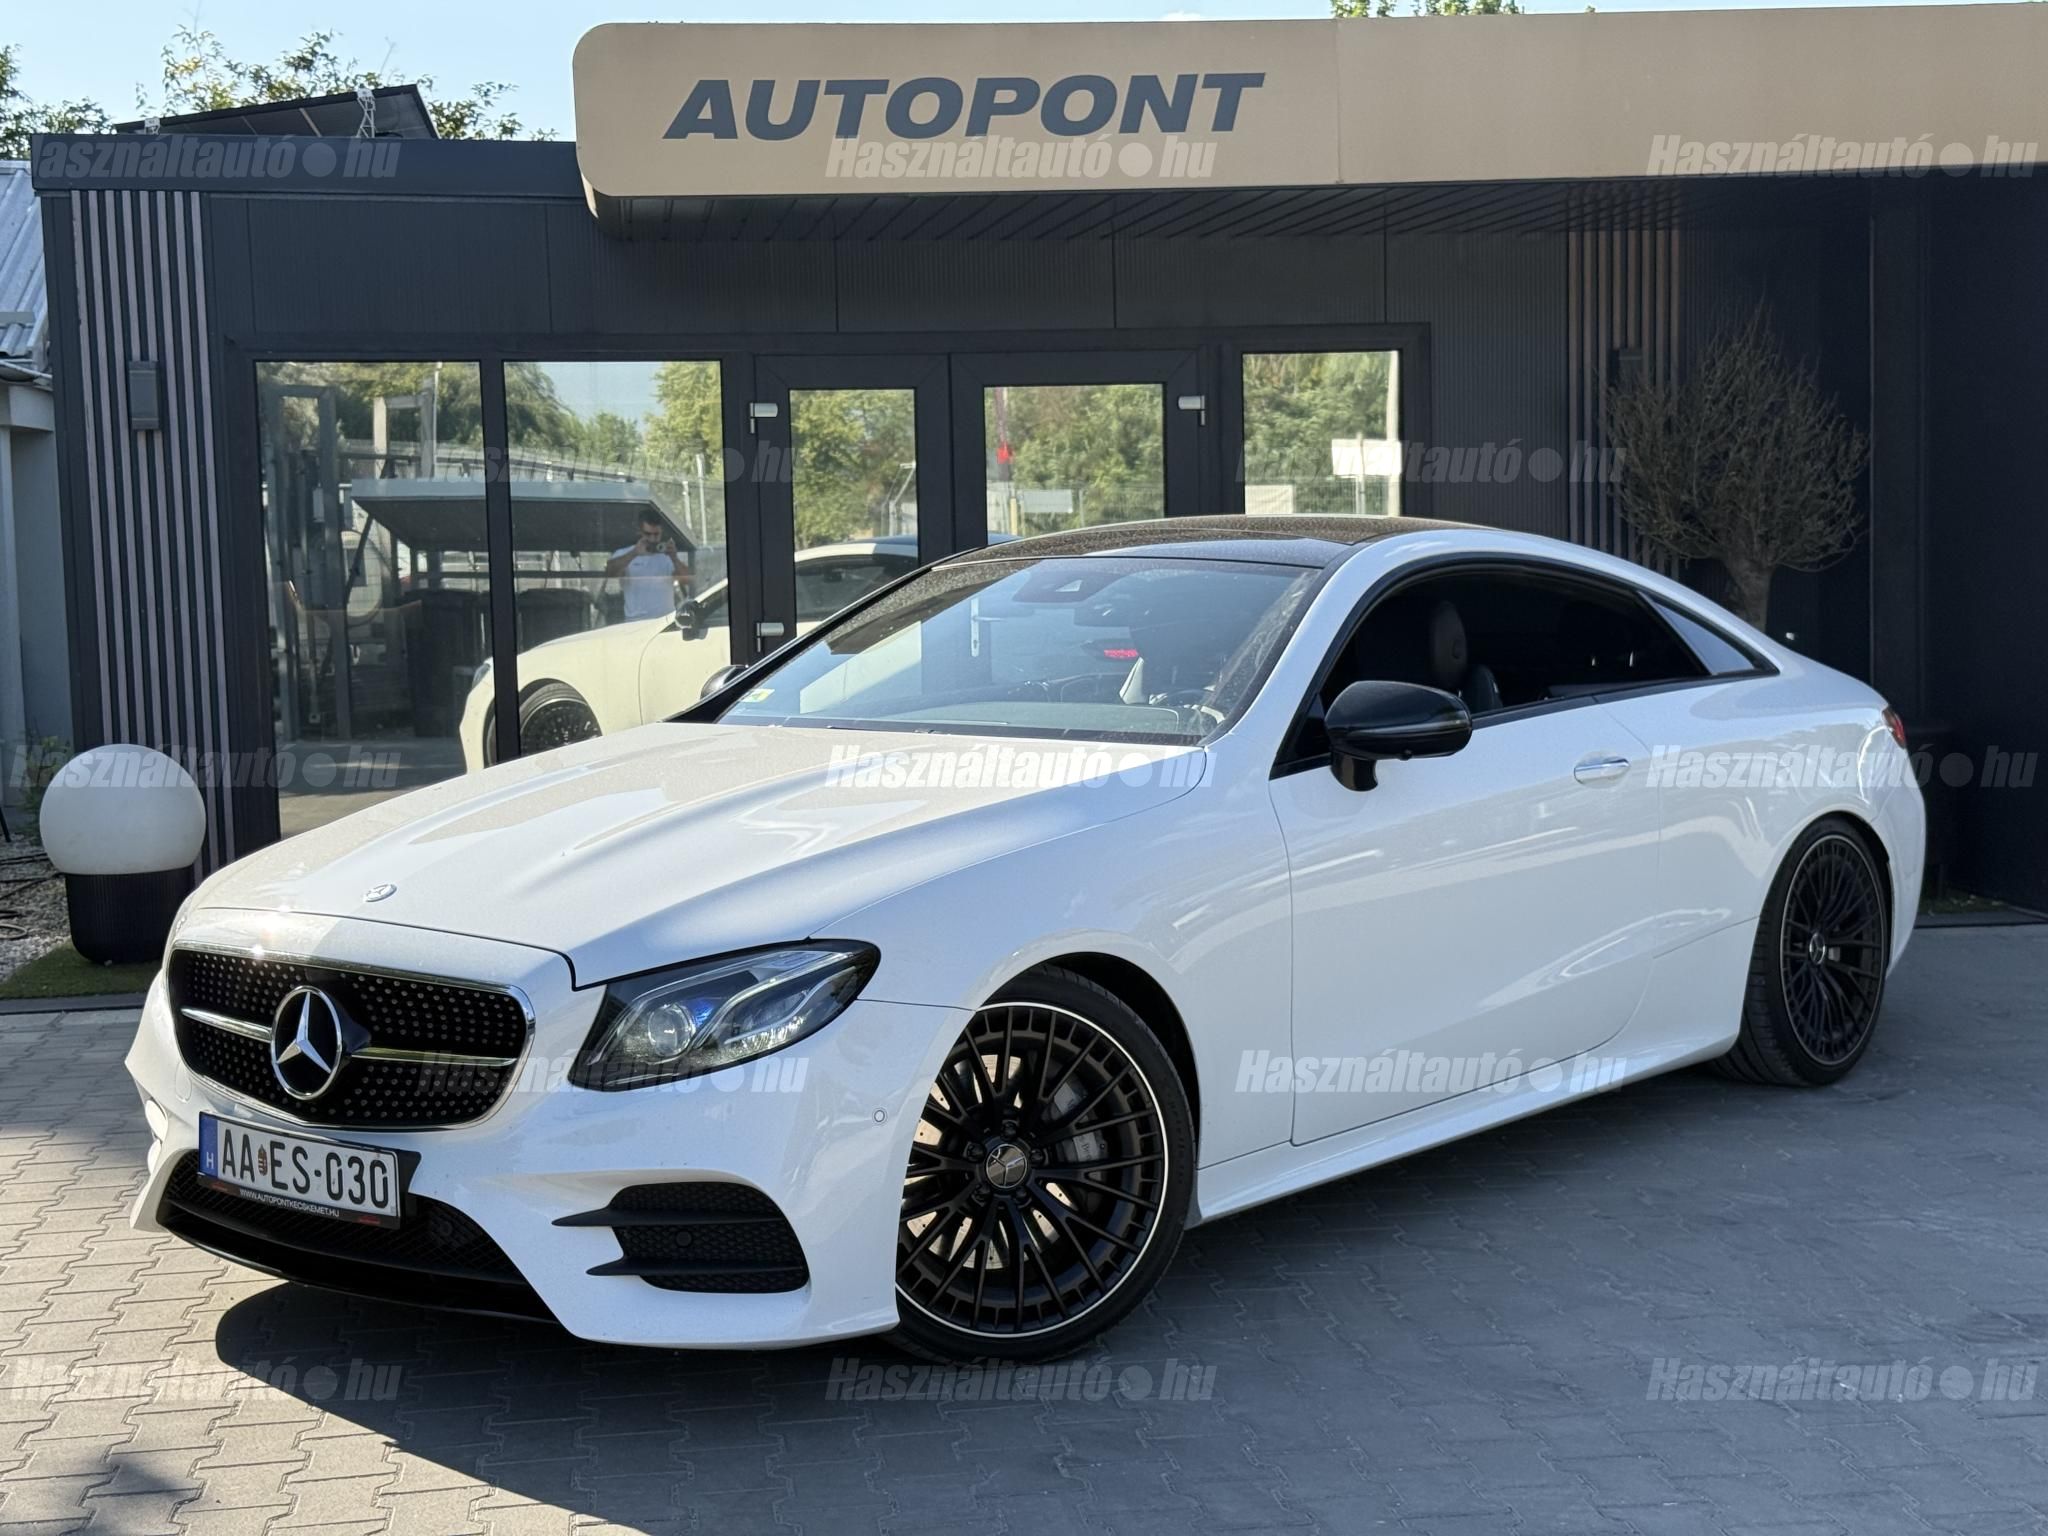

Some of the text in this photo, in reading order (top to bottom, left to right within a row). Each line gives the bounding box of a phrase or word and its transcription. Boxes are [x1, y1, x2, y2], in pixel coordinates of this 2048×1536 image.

[662, 71, 1266, 141] AUTOPONT
[205, 1151, 215, 1170] H
[222, 1128, 256, 1183] AA
